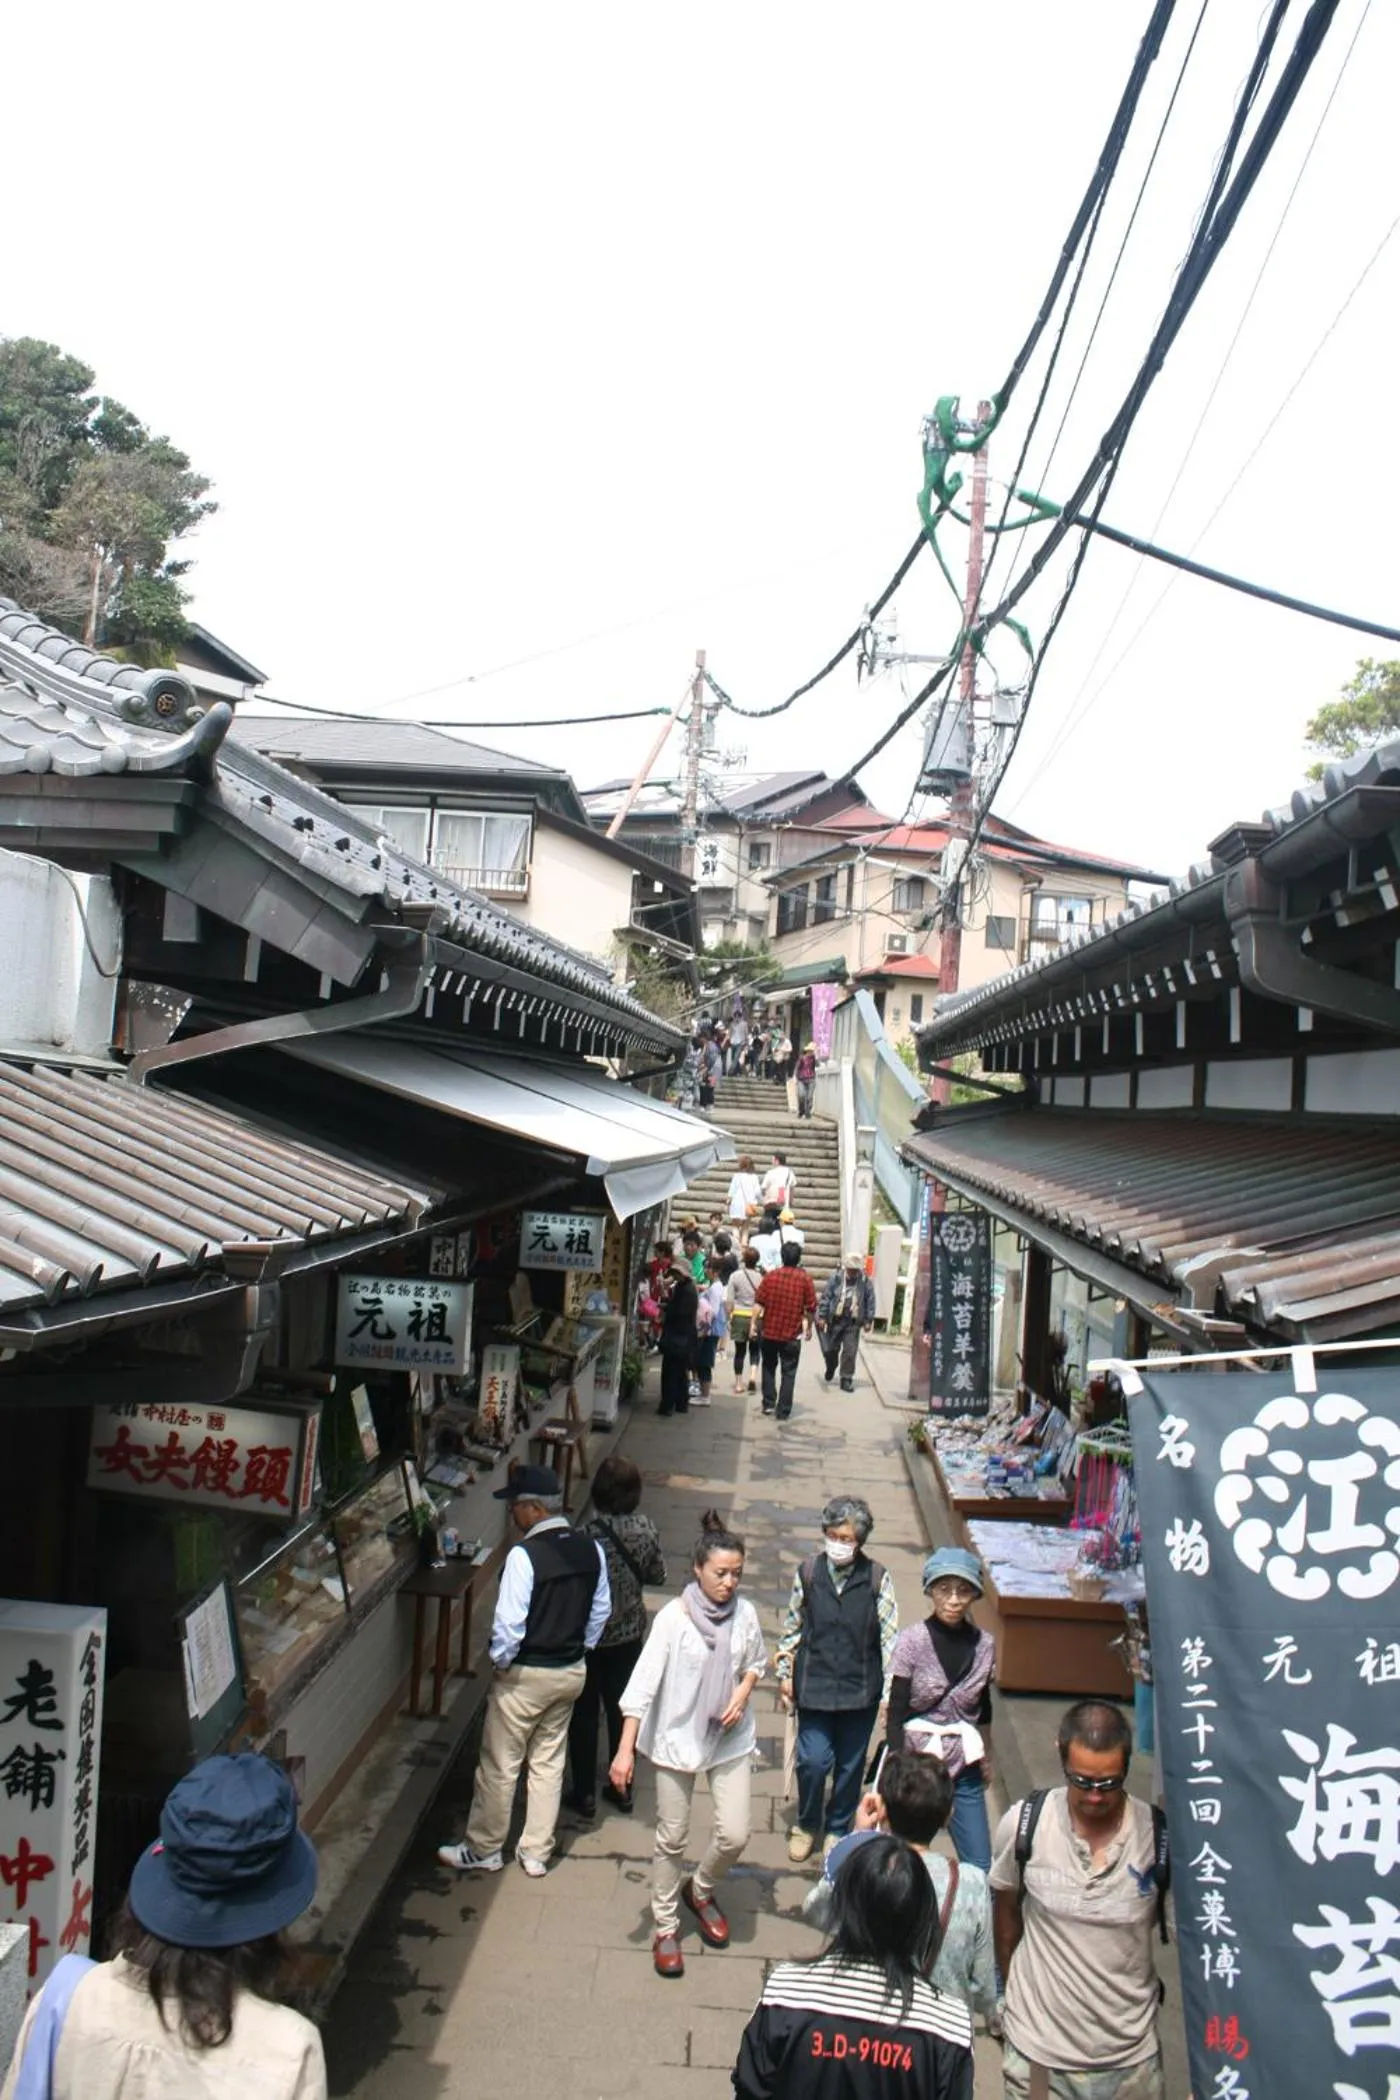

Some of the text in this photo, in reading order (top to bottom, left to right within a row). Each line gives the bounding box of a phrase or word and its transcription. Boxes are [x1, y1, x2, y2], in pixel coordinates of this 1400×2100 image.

[528, 1224, 593, 1256] 元祖
[348, 1297, 453, 1345] 元祖
[95, 1425, 293, 1507] 女夫饅頭
[1156, 1414, 1209, 1576] 名物
[1262, 1635, 1400, 1686] 元祖
[1278, 1723, 1400, 2100] 海苔
